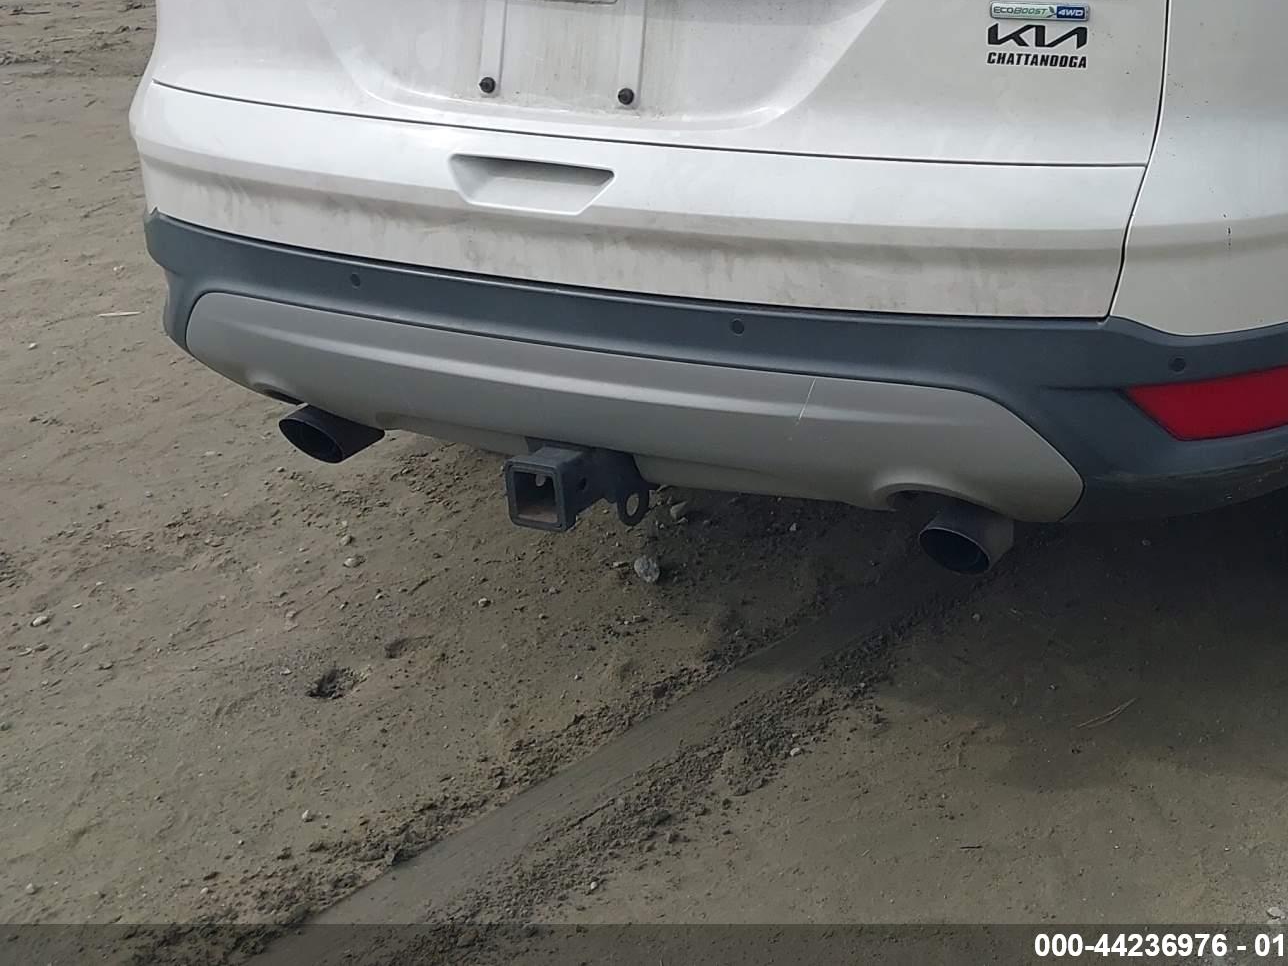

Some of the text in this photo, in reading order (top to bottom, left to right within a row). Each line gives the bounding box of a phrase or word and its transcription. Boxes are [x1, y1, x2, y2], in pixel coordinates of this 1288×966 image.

[1058, 9, 1084, 17] 4WD
[987, 23, 1088, 49] KIA
[987, 52, 1087, 68] CHATTANOOGA
